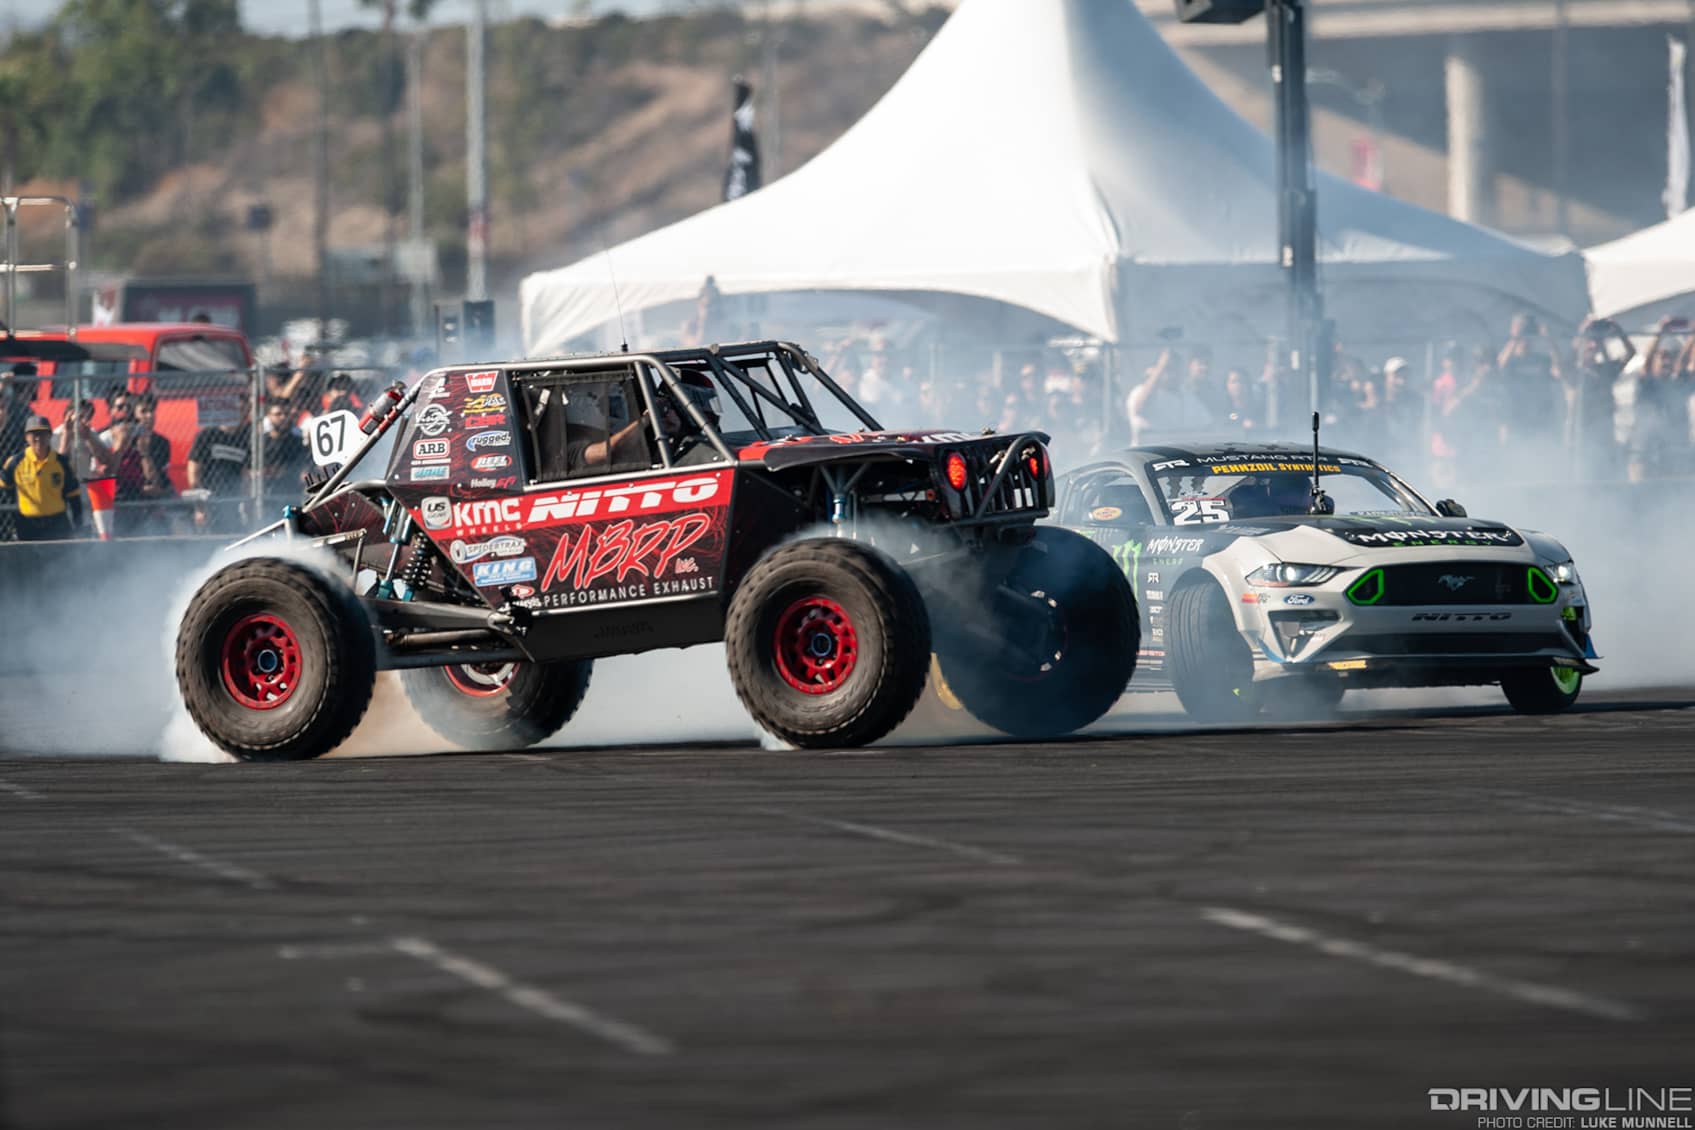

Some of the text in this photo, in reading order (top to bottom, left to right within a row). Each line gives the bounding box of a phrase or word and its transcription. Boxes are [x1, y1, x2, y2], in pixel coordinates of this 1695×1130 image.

[316, 414, 345, 457] 67
[418, 442, 446, 455] ARB
[1196, 453, 1287, 464] MUSTANG
[1211, 463, 1278, 475] PENNZOIL
[427, 502, 446, 512] US
[528, 477, 719, 523] NITTO
[1171, 500, 1231, 526] 25
[456, 522, 523, 537] WHEELS
[540, 512, 711, 593] MBRP
[477, 560, 531, 577] KING
[543, 583, 646, 608] PERFORMANCE
[653, 576, 714, 596] EXHAUST
[1287, 595, 1311, 606] Ford
[1411, 612, 1512, 622] NITTO
